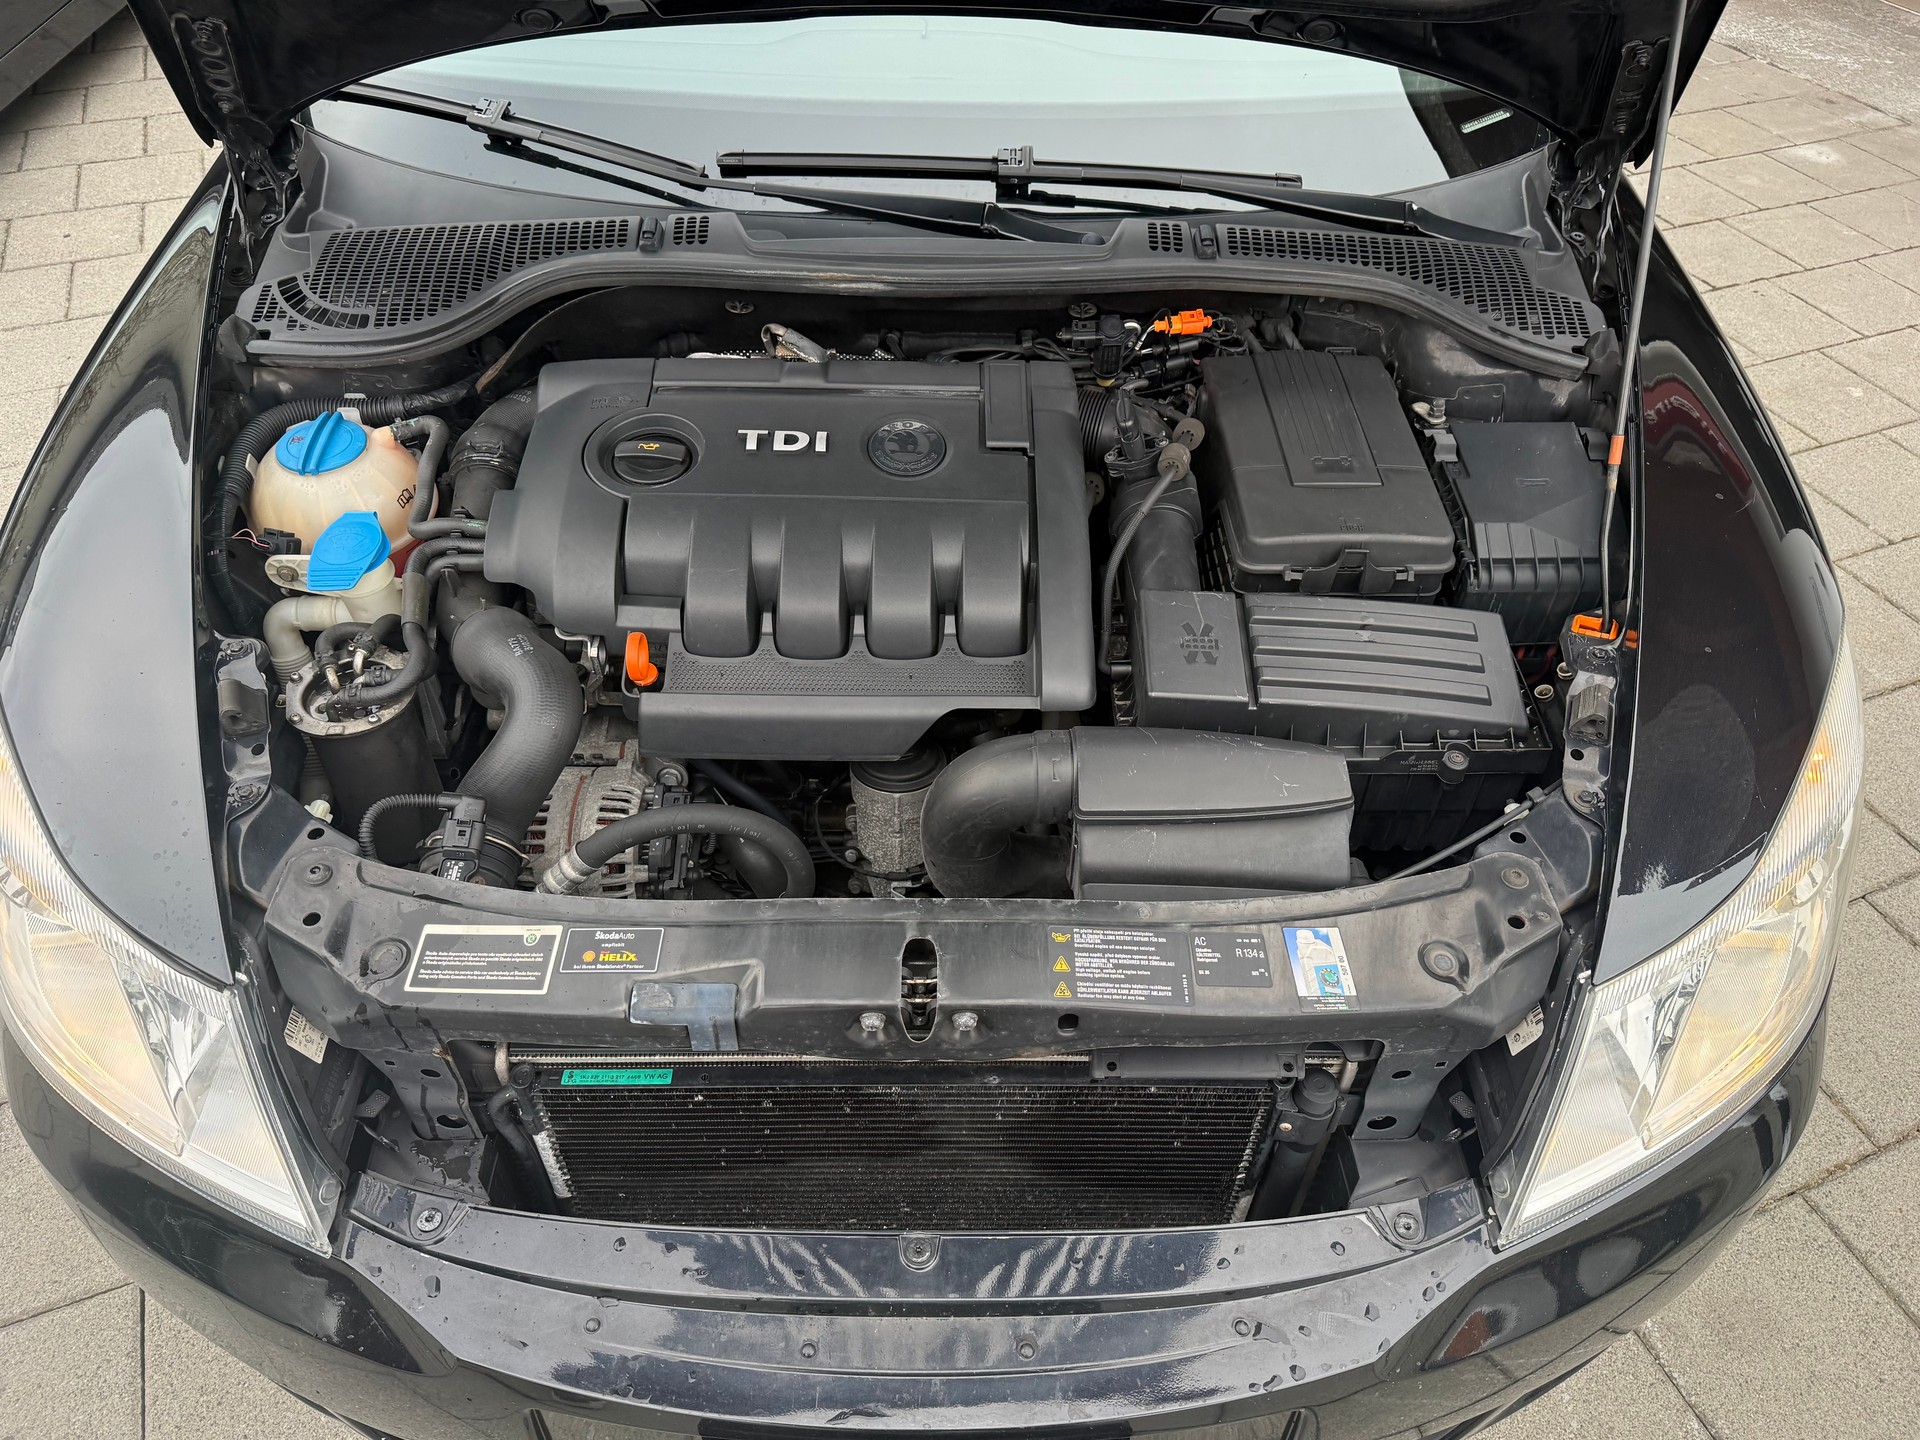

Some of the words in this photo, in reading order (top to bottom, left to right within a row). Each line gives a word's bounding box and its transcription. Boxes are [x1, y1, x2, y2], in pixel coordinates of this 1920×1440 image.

[738, 429, 828, 452] TDI
[1195, 936, 1206, 945] AC
[599, 953, 638, 961] HELIX
